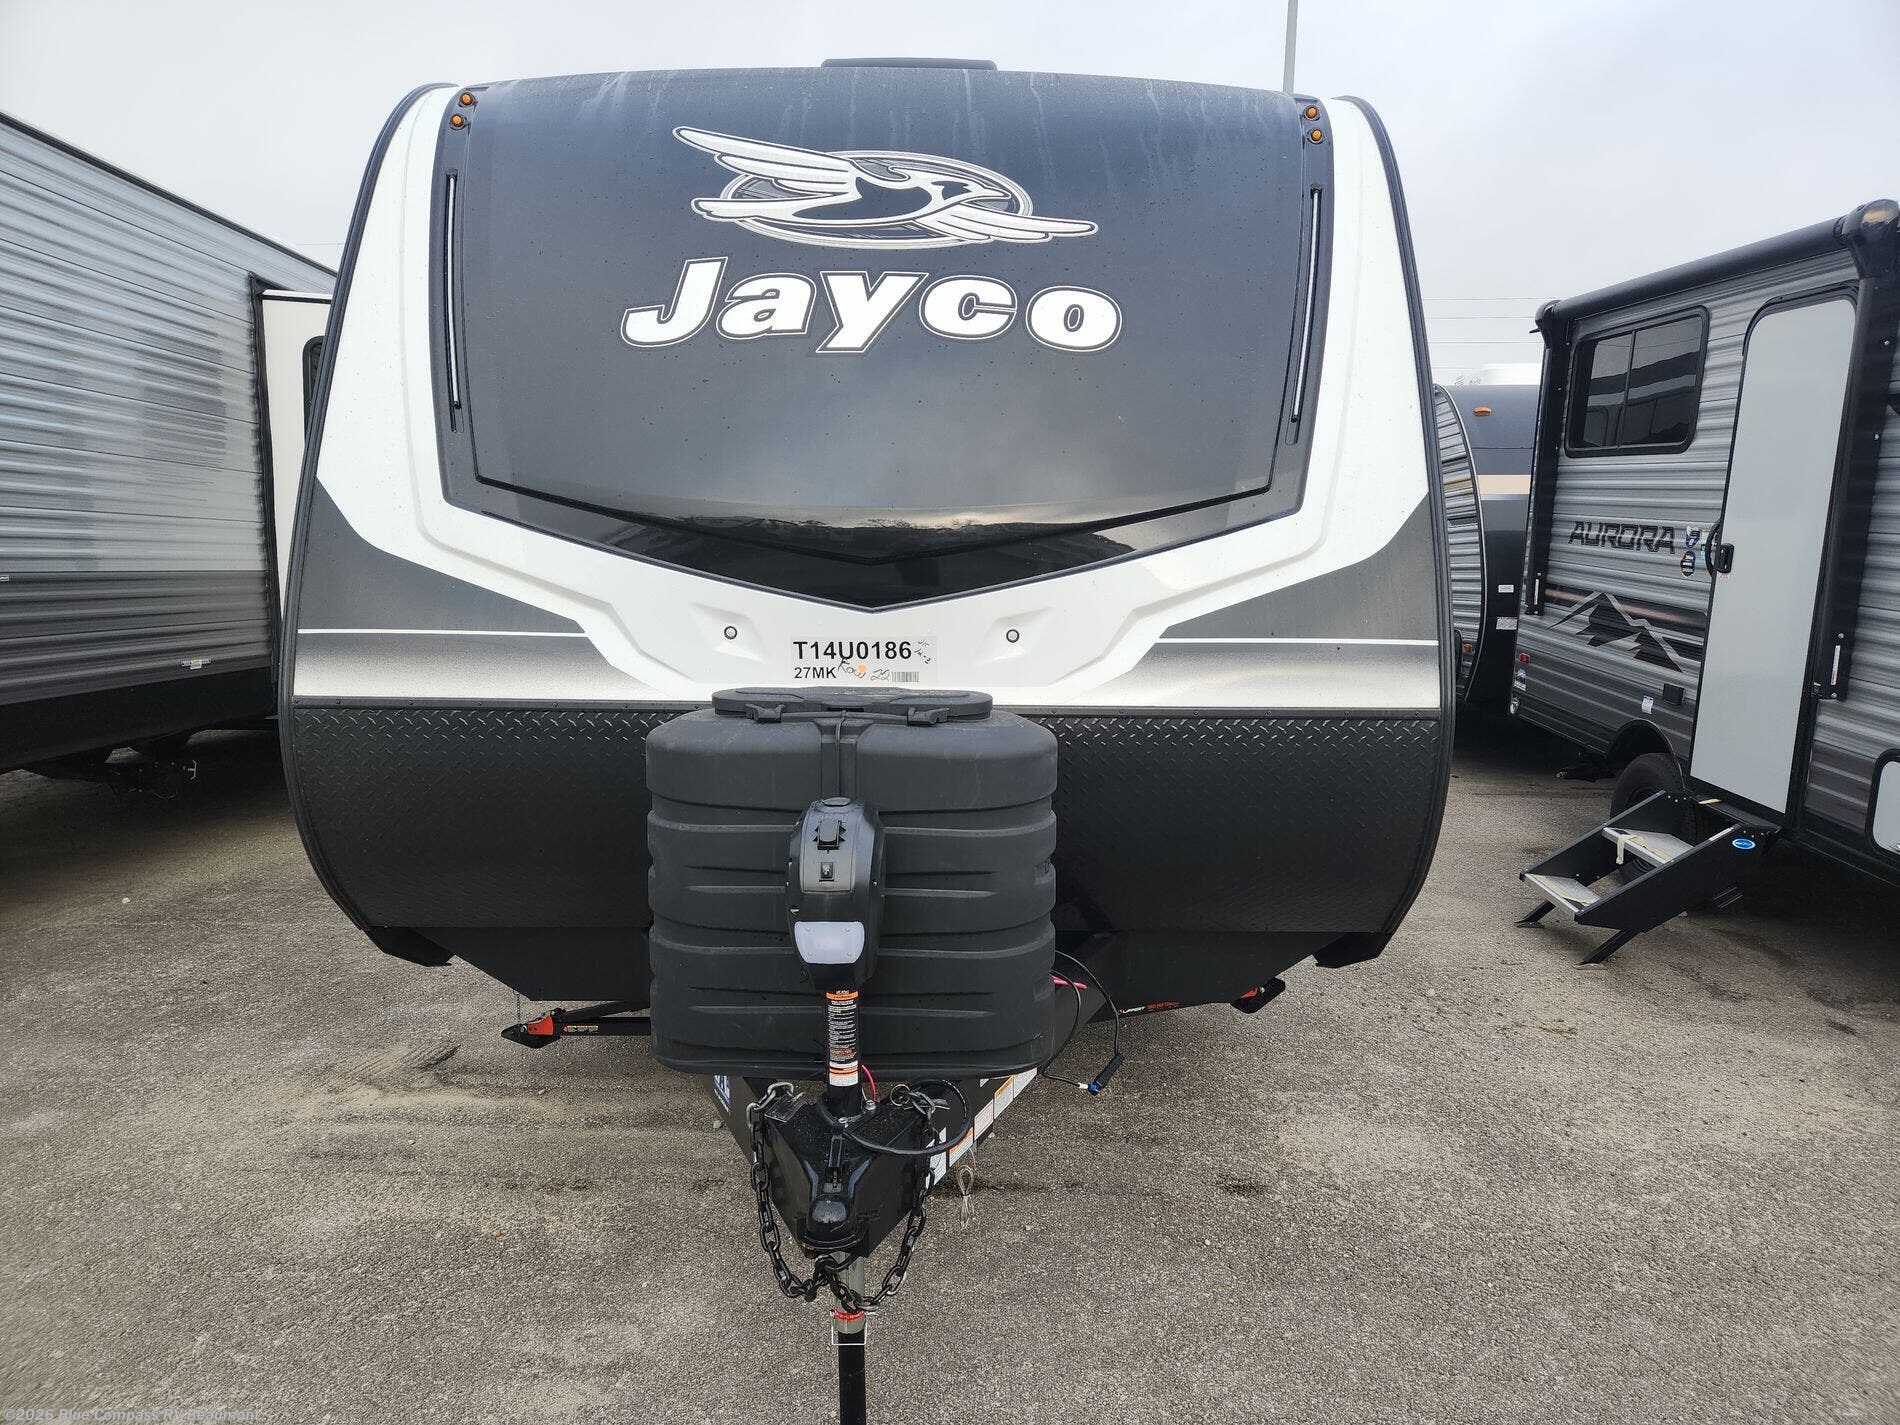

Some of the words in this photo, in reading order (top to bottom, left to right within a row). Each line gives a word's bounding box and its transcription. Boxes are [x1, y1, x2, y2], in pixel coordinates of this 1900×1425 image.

[621, 256, 1123, 354] Jayco
[1568, 521, 1676, 555] AURORA
[793, 641, 912, 660] T14U0186
[794, 666, 837, 679] 27MK
